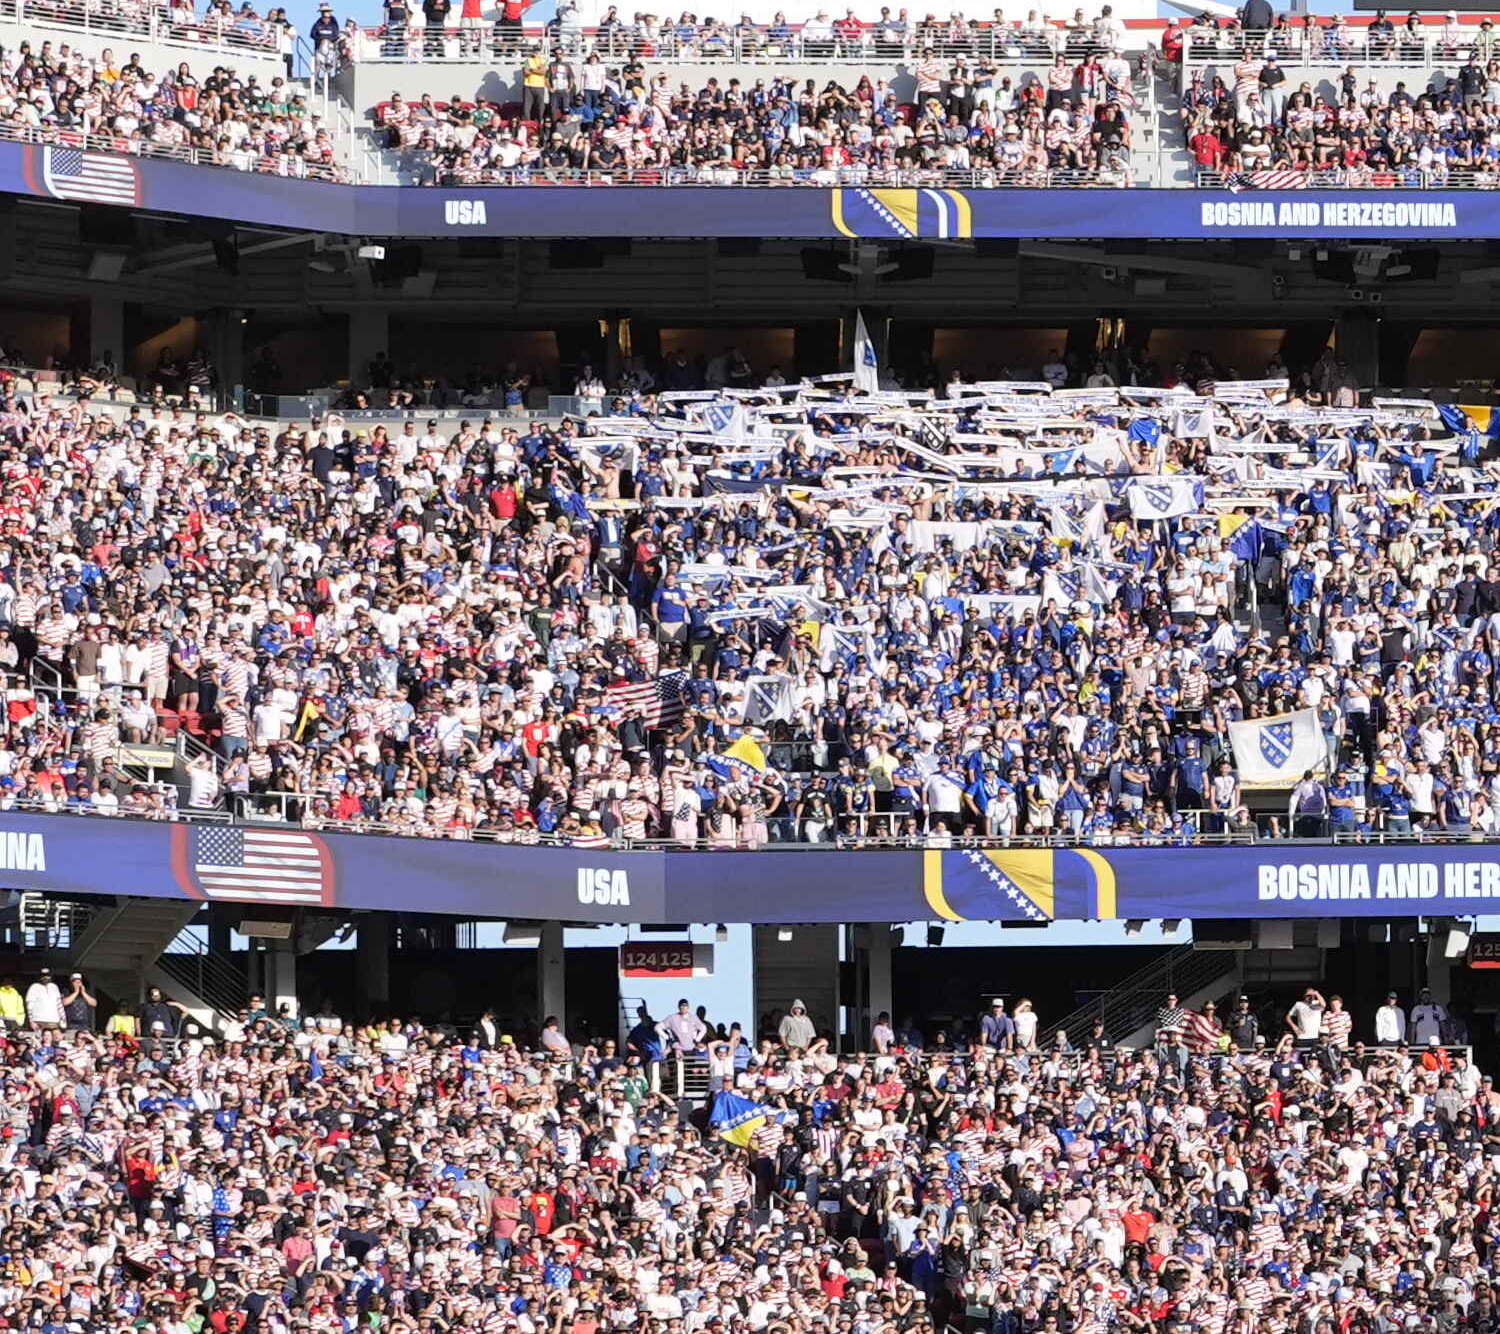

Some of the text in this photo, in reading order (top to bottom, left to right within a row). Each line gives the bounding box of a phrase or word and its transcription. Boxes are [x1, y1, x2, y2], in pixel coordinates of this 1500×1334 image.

[445, 199, 487, 225] USA
[1201, 202, 1457, 228] BOSNIA AND HERZEGOVINA
[577, 867, 630, 906] USA
[1257, 864, 1376, 901] BOSNIA
[1377, 863, 1438, 899] AND
[626, 952, 692, 967] 124 125
